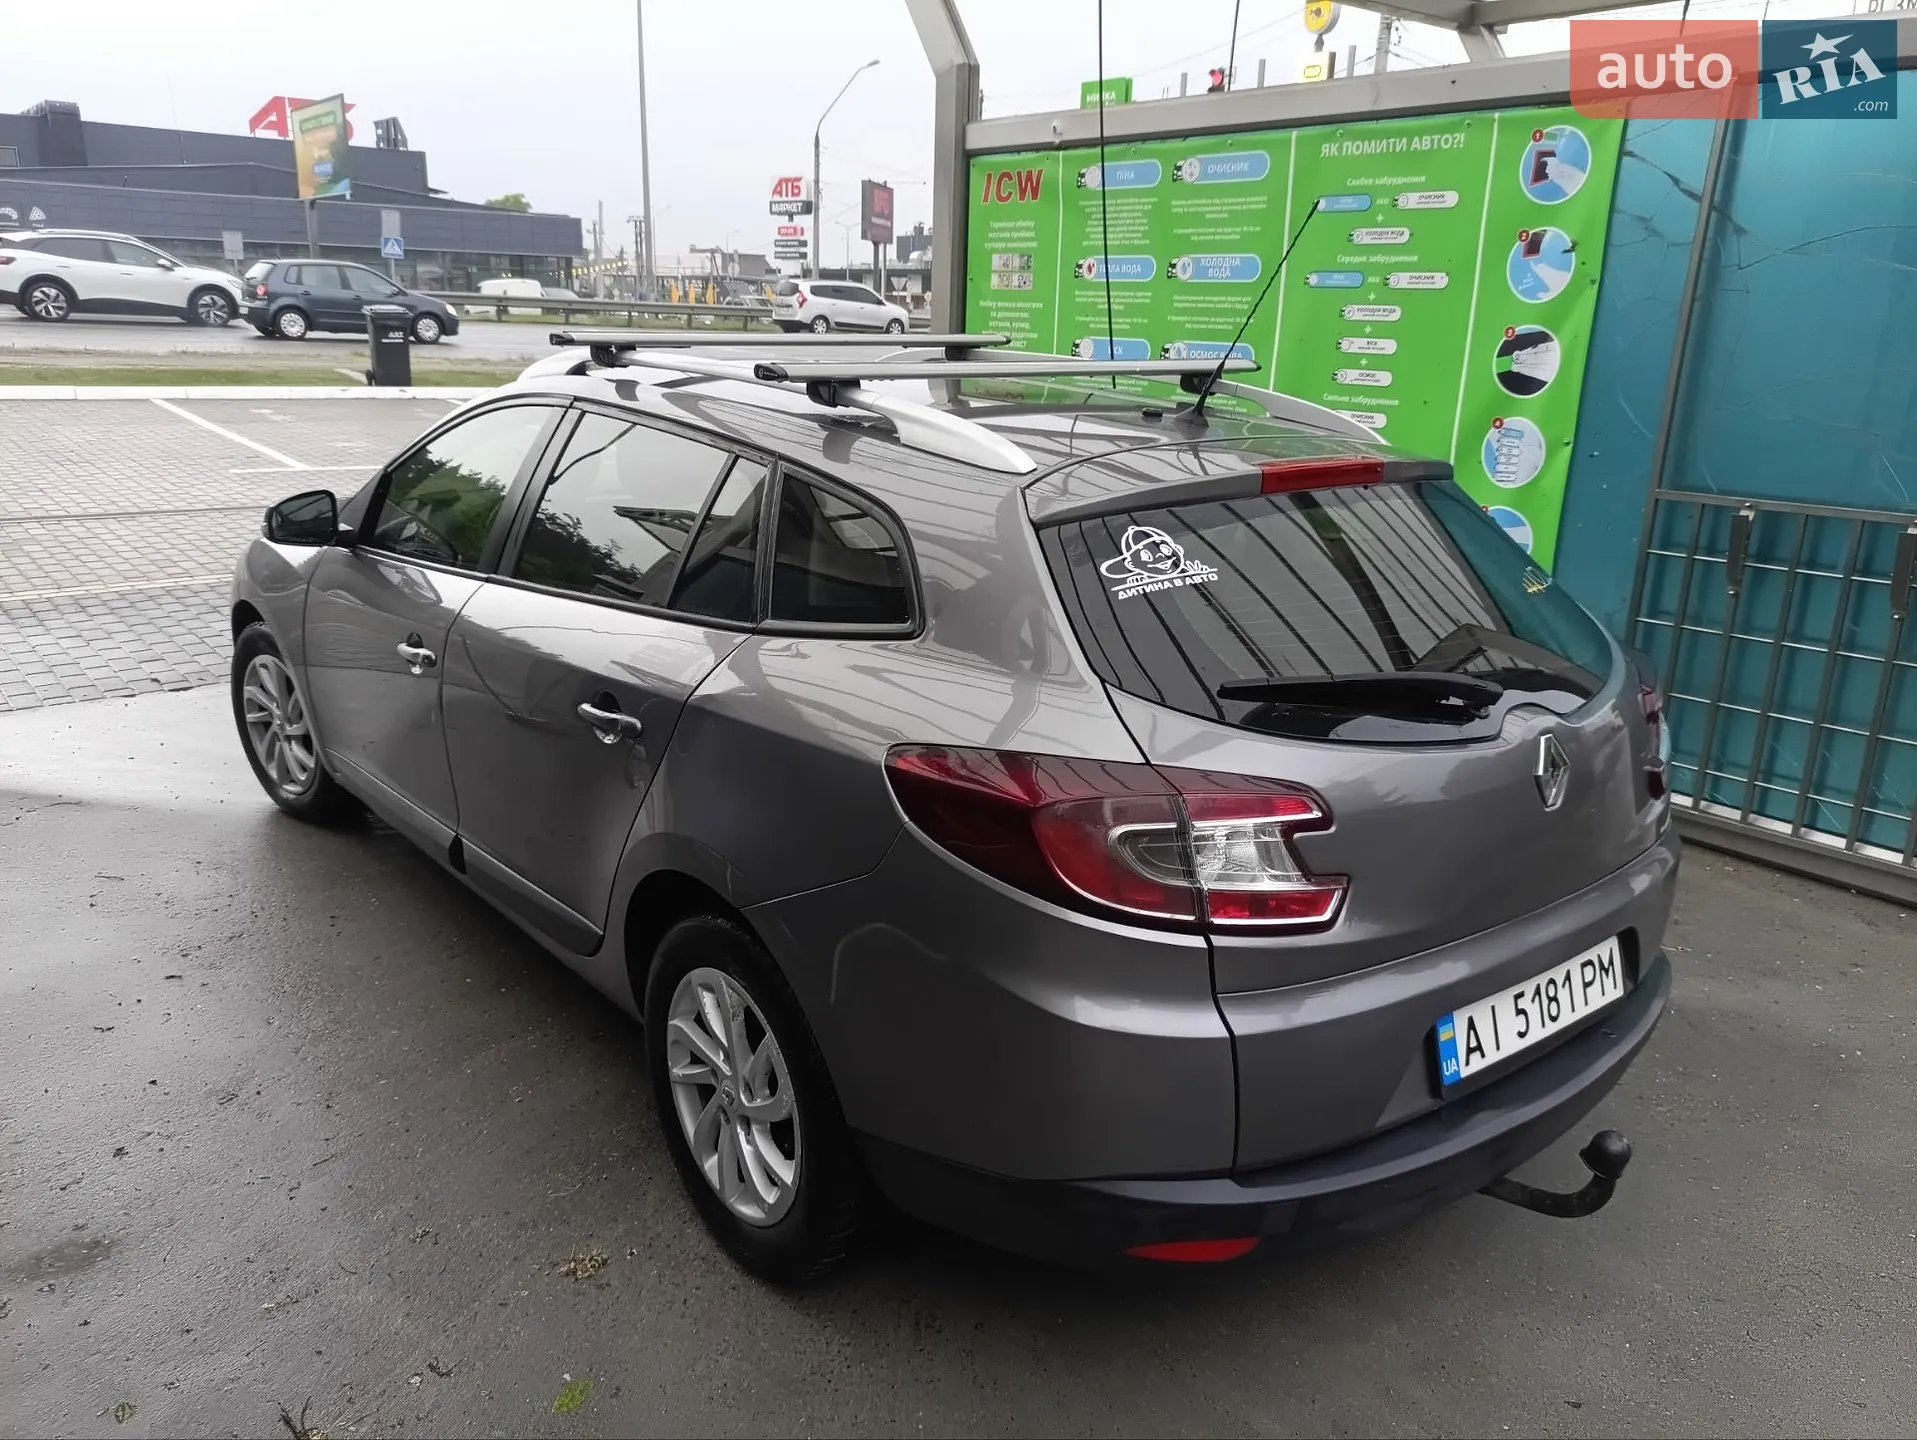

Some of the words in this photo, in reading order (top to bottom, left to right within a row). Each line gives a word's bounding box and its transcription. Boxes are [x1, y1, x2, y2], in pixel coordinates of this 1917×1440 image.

[1320, 143, 1339, 158] ЯК
[1342, 137, 1407, 156] ПОМИТИ
[1410, 132, 1465, 151] АВТО?!
[1207, 161, 1249, 175] ОЧИСНИК
[772, 176, 803, 198] АТБ
[982, 168, 1045, 204] ICW
[772, 202, 803, 213] МАРКЕТ
[1121, 263, 1142, 276] ВОДА
[1200, 256, 1241, 268] ХОЛОДНА
[1208, 267, 1231, 278] ВОДА
[1118, 582, 1173, 600] ДИТИНА
[1174, 577, 1185, 588] В
[1185, 572, 1219, 586] АВТО
[1464, 1004, 1501, 1067] AI
[1512, 968, 1576, 1040] 5181
[1579, 946, 1618, 1007] PM
[1442, 1056, 1460, 1077] UA
